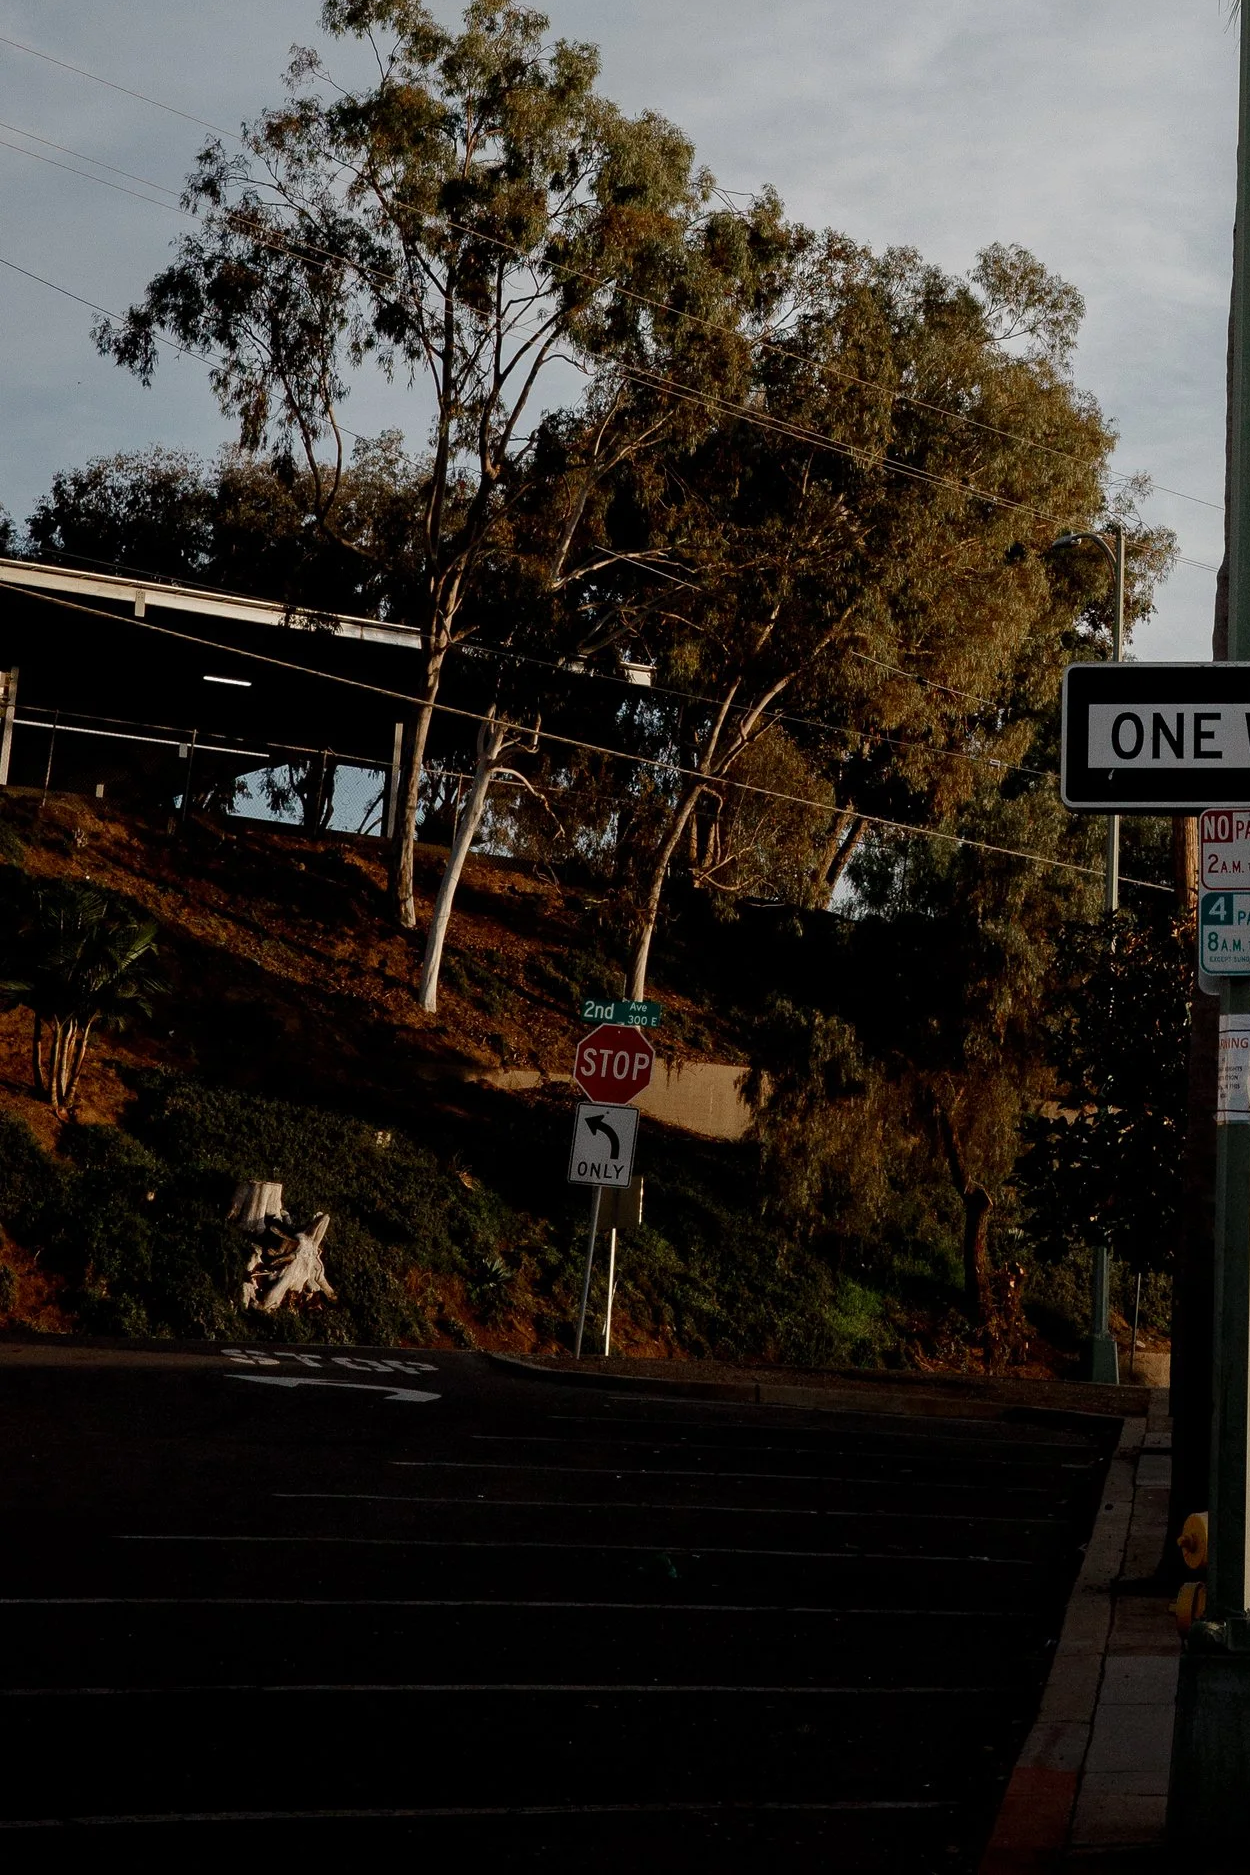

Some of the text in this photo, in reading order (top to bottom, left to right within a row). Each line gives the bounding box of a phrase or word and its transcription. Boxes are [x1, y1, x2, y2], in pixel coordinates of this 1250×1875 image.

[1111, 712, 1222, 760] ONE
[1203, 815, 1230, 840] NO
[1208, 896, 1227, 922] 4
[583, 1000, 648, 1020] 2nd Ave
[627, 1015, 658, 1027] 300 E
[580, 1048, 650, 1081] STOP
[577, 1161, 624, 1179] ONLY
[220, 1348, 440, 1375] STOP
